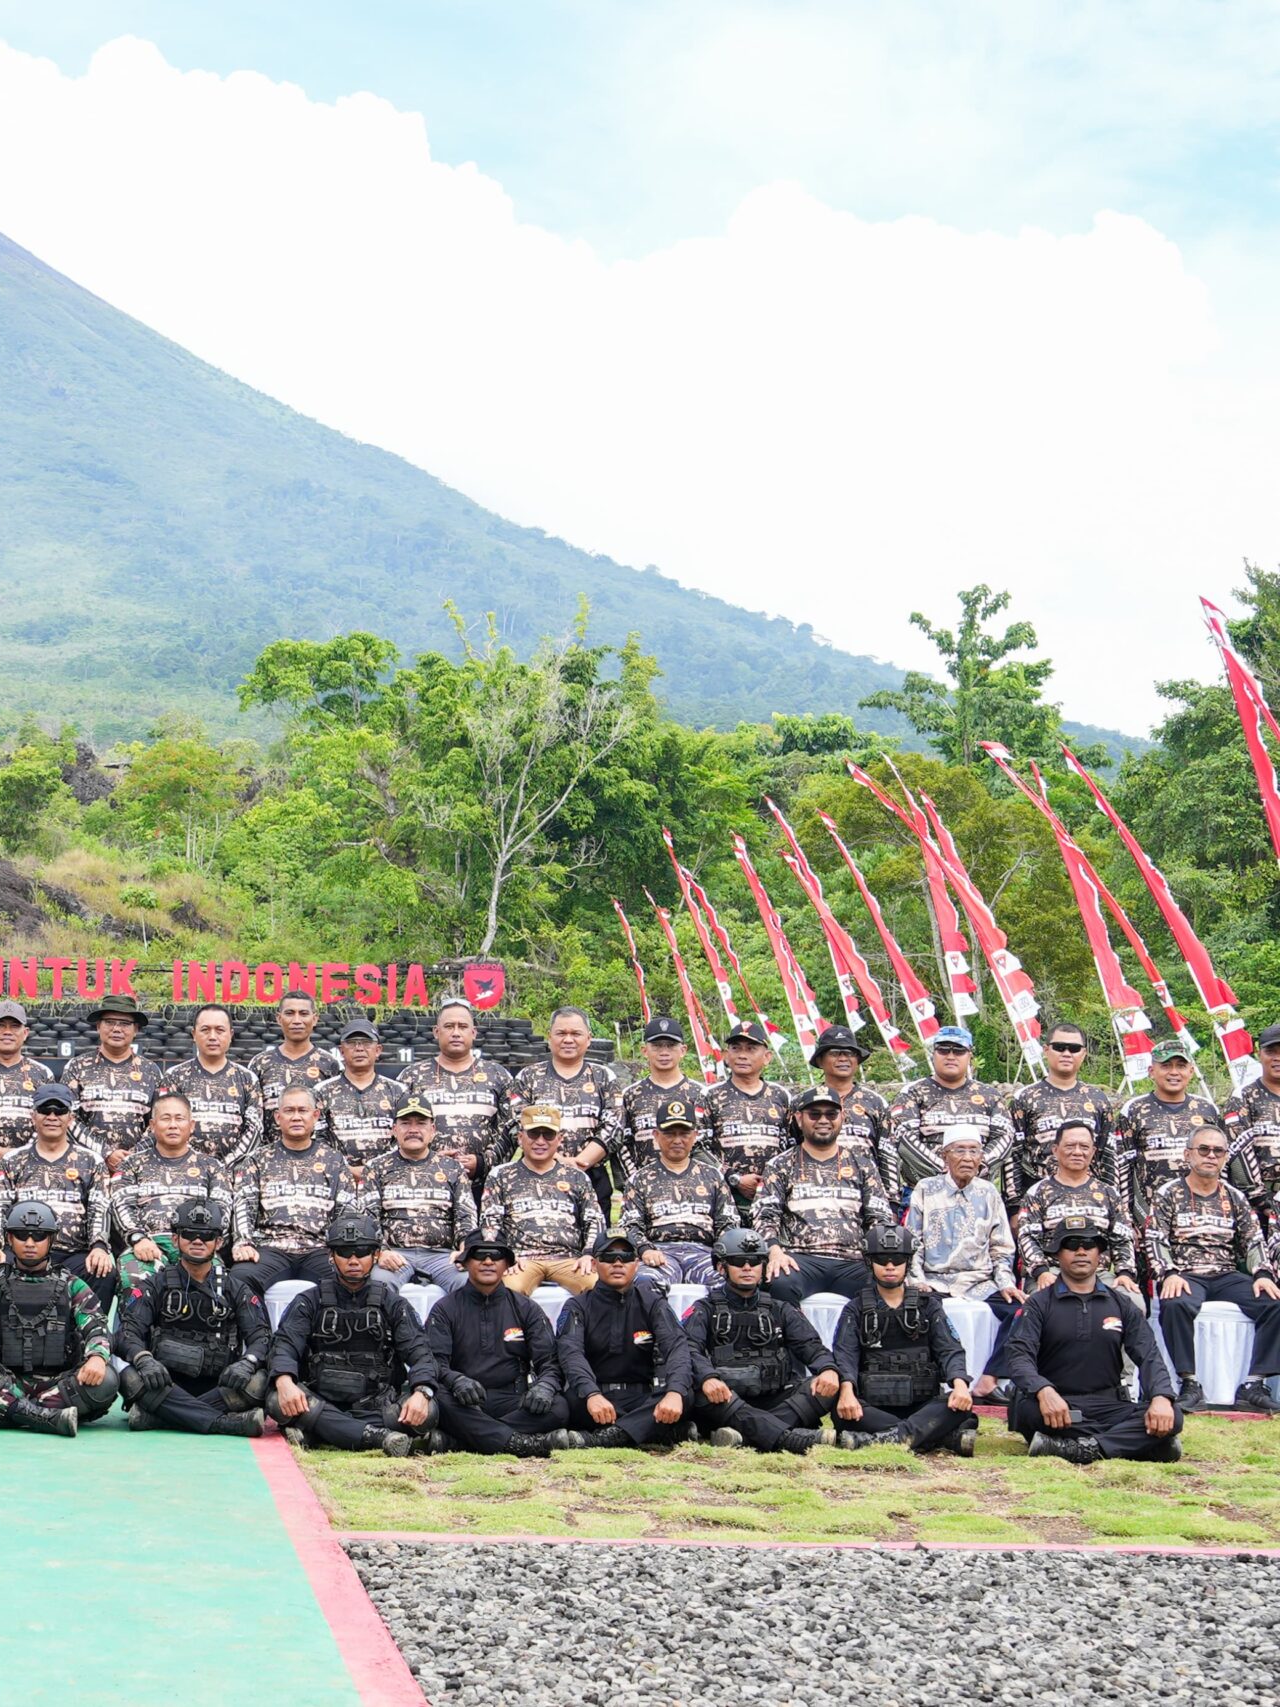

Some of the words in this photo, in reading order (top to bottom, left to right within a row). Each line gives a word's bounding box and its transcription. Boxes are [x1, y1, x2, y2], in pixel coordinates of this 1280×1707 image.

[173, 959, 429, 1006] INDONESIA
[61, 1042, 72, 1057] 6
[399, 1048, 412, 1062] 11
[82, 1088, 149, 1104] SHOOTER
[190, 1100, 241, 1113] HOOTER
[334, 1117, 394, 1129] SHOOTER
[923, 1114, 990, 1126] SHOOTER
[19, 1189, 81, 1202] SHOOTER
[139, 1184, 207, 1197] SHOOTER
[266, 1183, 331, 1199] SHOOTER
[384, 1186, 451, 1200] SHOOTER
[791, 1186, 861, 1200] SHOOTER
[513, 1200, 574, 1213] SHOOTER
[653, 1202, 711, 1216] SHOOTER
